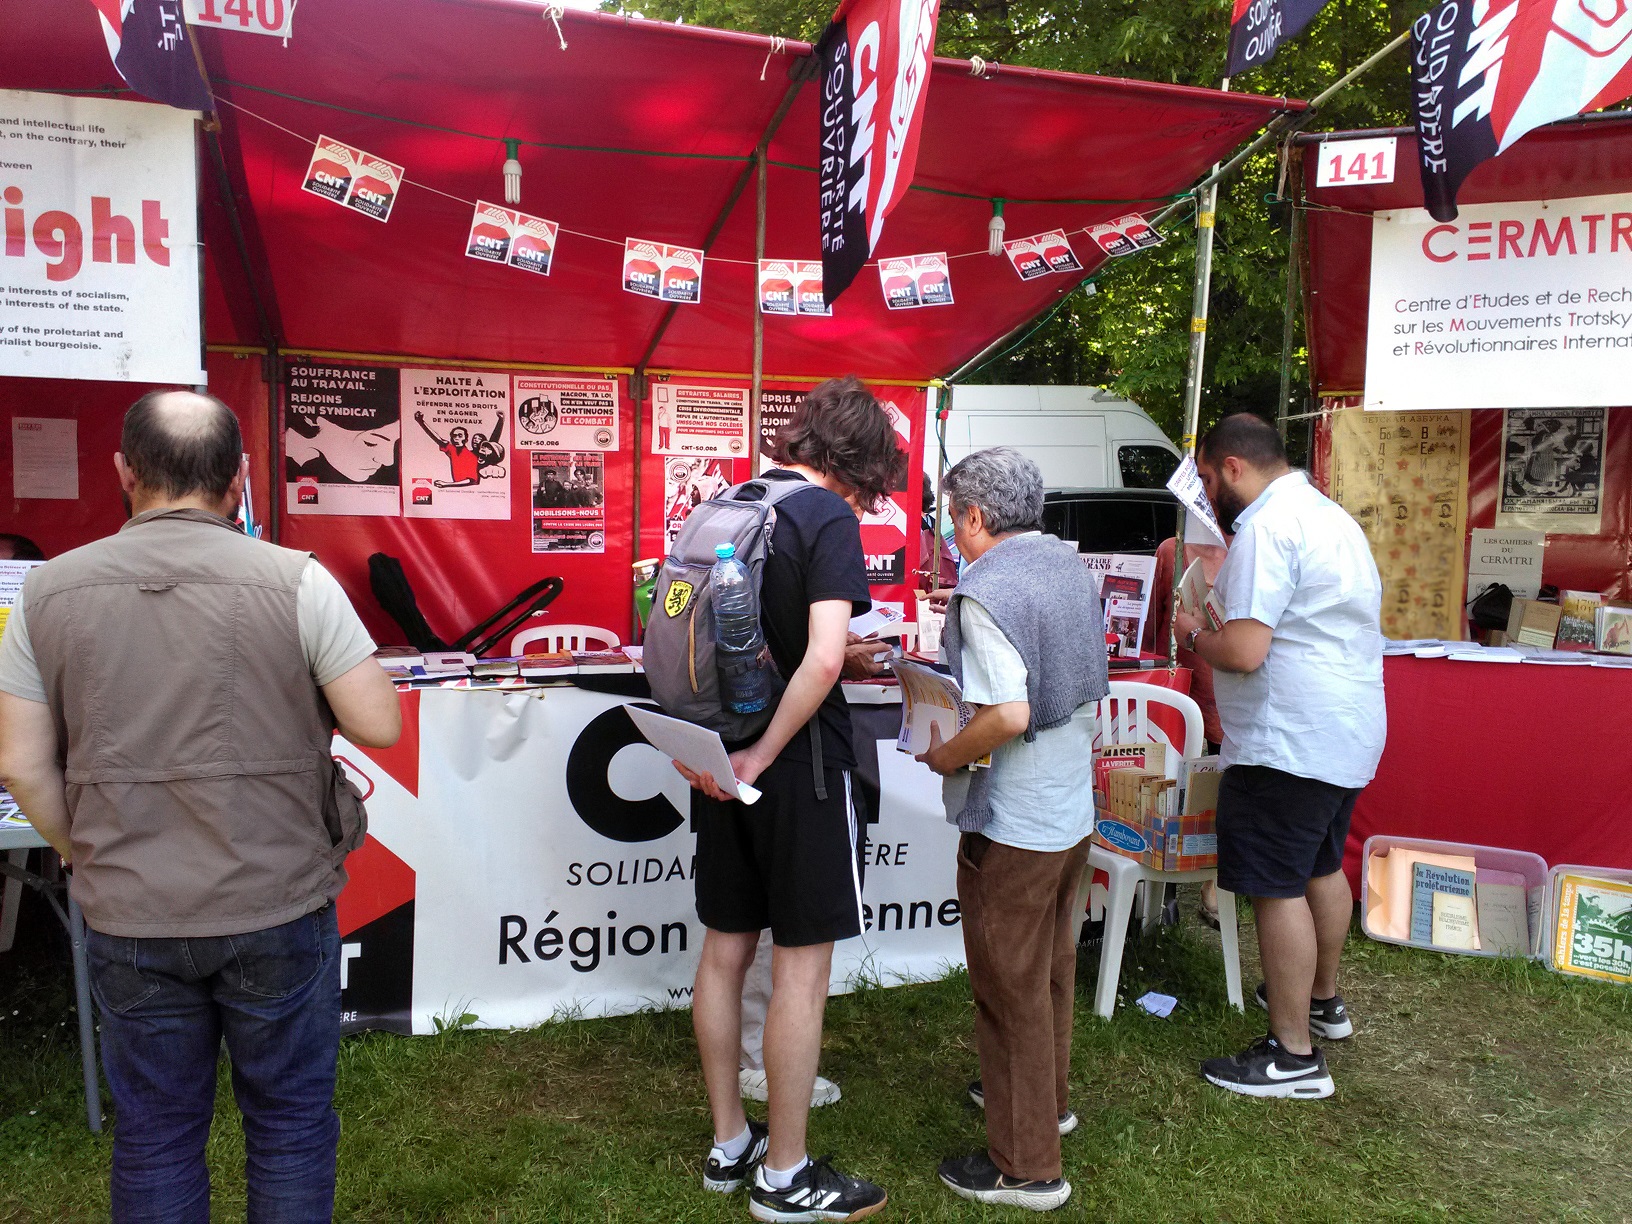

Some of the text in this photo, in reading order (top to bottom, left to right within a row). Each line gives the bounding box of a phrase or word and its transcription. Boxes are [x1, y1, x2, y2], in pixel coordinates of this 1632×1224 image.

[848, 21, 880, 214] CNT
[0, 118, 105, 134] and intellectual life
[27, 133, 44, 141] the
[48, 134, 97, 148] contrary,
[100, 138, 127, 149] their
[831, 42, 847, 252] SOLIDARITÉ
[822, 70, 835, 251] OUVRIÈRE
[1328, 151, 1388, 183] 141
[315, 171, 344, 189] CNT
[357, 187, 386, 206] CNT
[0, 186, 170, 281] ight
[1133, 230, 1152, 240] CNT
[476, 235, 504, 250] CNT
[1105, 238, 1126, 249] CNT
[517, 247, 545, 262] CNT
[1050, 254, 1070, 265] CNT
[1020, 259, 1041, 270] CNT
[629, 271, 656, 285] CNT
[668, 278, 694, 291] CNT
[9, 286, 58, 297] interests
[76, 291, 129, 301] socialism,
[889, 286, 912, 298] CNT
[923, 283, 945, 294] CNT
[765, 290, 790, 302] CNT
[1395, 287, 1632, 313] Centre d'Etudes et de Rech
[5, 300, 124, 313] interests of the state.
[1393, 311, 1632, 335] sur les Mouvements Trotsky
[7, 325, 19, 333] of
[23, 326, 40, 334] the
[43, 327, 100, 338] proletariat
[104, 331, 123, 339] and
[35, 340, 102, 350] bourgeoisie.
[1393, 343, 1409, 357] et
[1414, 338, 1558, 356] Révolutionnaires
[290, 367, 376, 380] SOUFFRANCE
[290, 378, 376, 391] AU TRAVAIL...
[436, 376, 483, 387] HALTE À
[520, 382, 585, 390] CONSTITUTIONNELLE
[290, 393, 343, 404] REJOINS
[414, 386, 506, 399] L'EXPLOITATION
[762, 393, 792, 403] ÉPRIS
[416, 400, 453, 408] DÉFENDRE
[290, 405, 376, 417] TON SYNDICAT
[561, 407, 614, 415] CONTINUONS
[534, 509, 599, 517] MOBILISONS-NOUS
[1481, 556, 1533, 566] CERMTRI
[1416, 867, 1470, 886] la Révolution
[1563, 907, 1570, 918] la
[499, 910, 687, 972] Région
[1573, 933, 1632, 962] 35h
